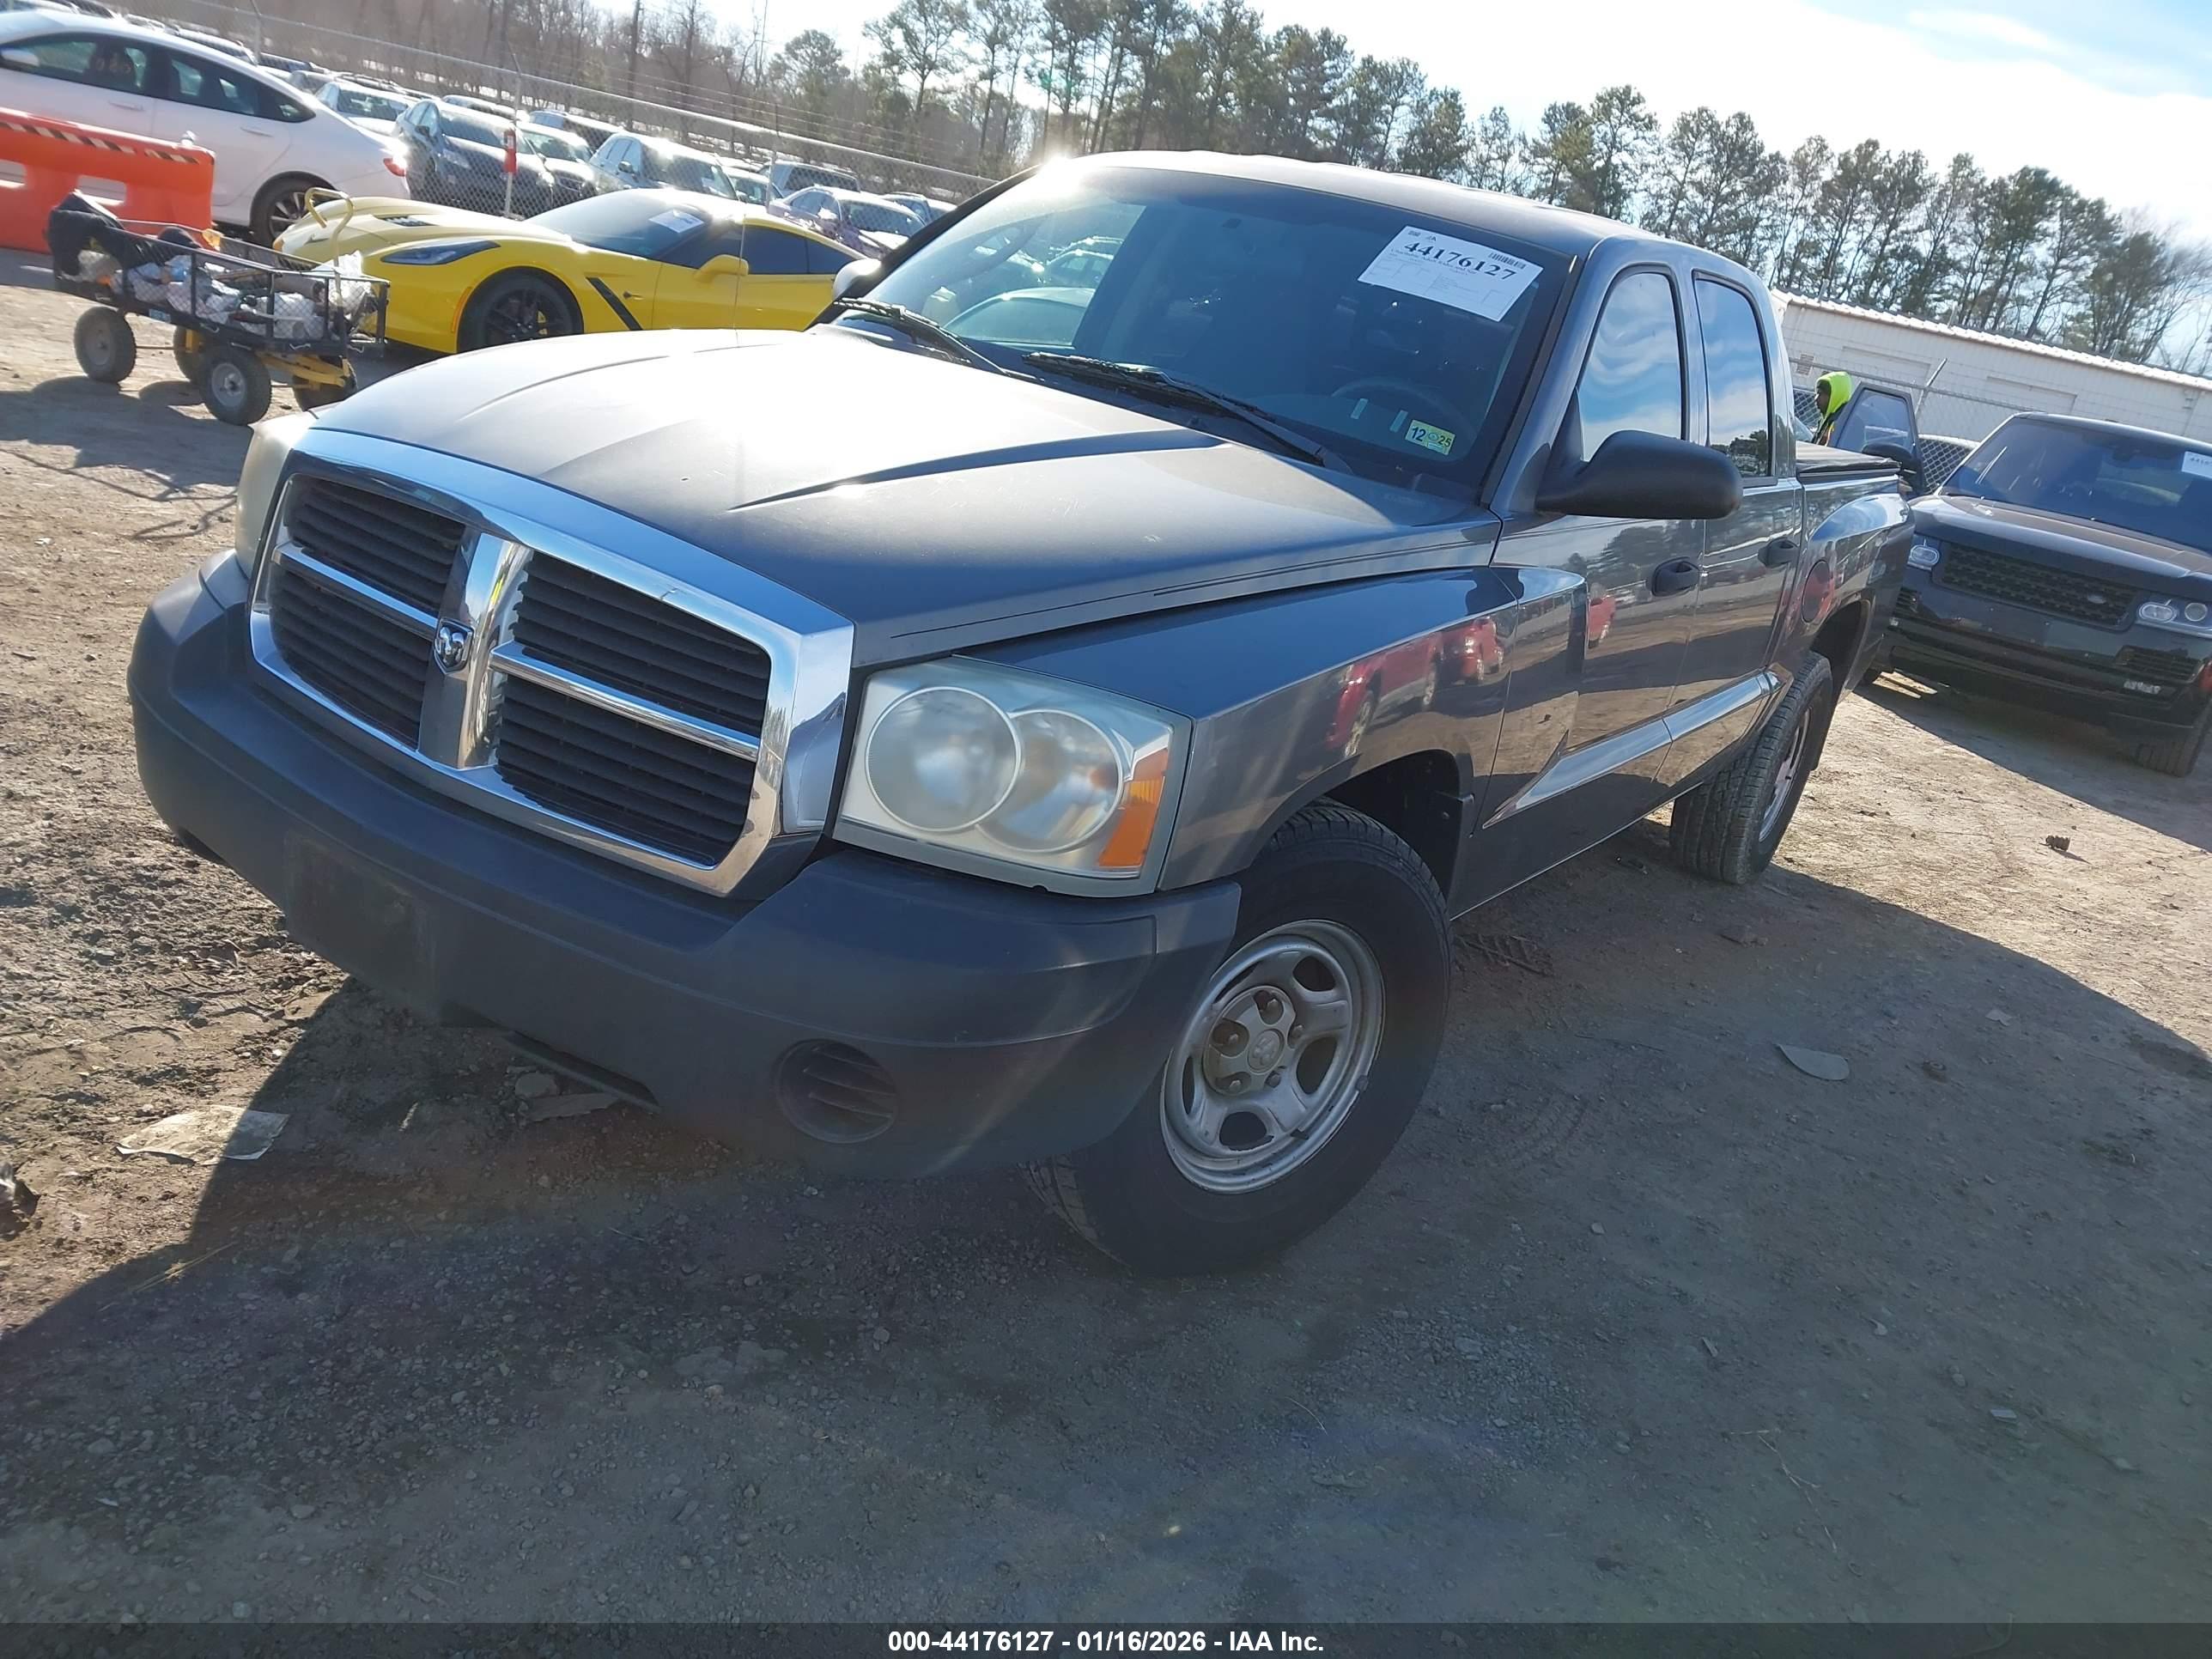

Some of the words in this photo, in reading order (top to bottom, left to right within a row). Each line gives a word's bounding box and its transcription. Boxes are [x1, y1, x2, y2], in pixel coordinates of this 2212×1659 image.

[1404, 242, 1517, 279] 44176127
[1412, 426, 1426, 442] 12
[1437, 434, 1452, 447] 25
